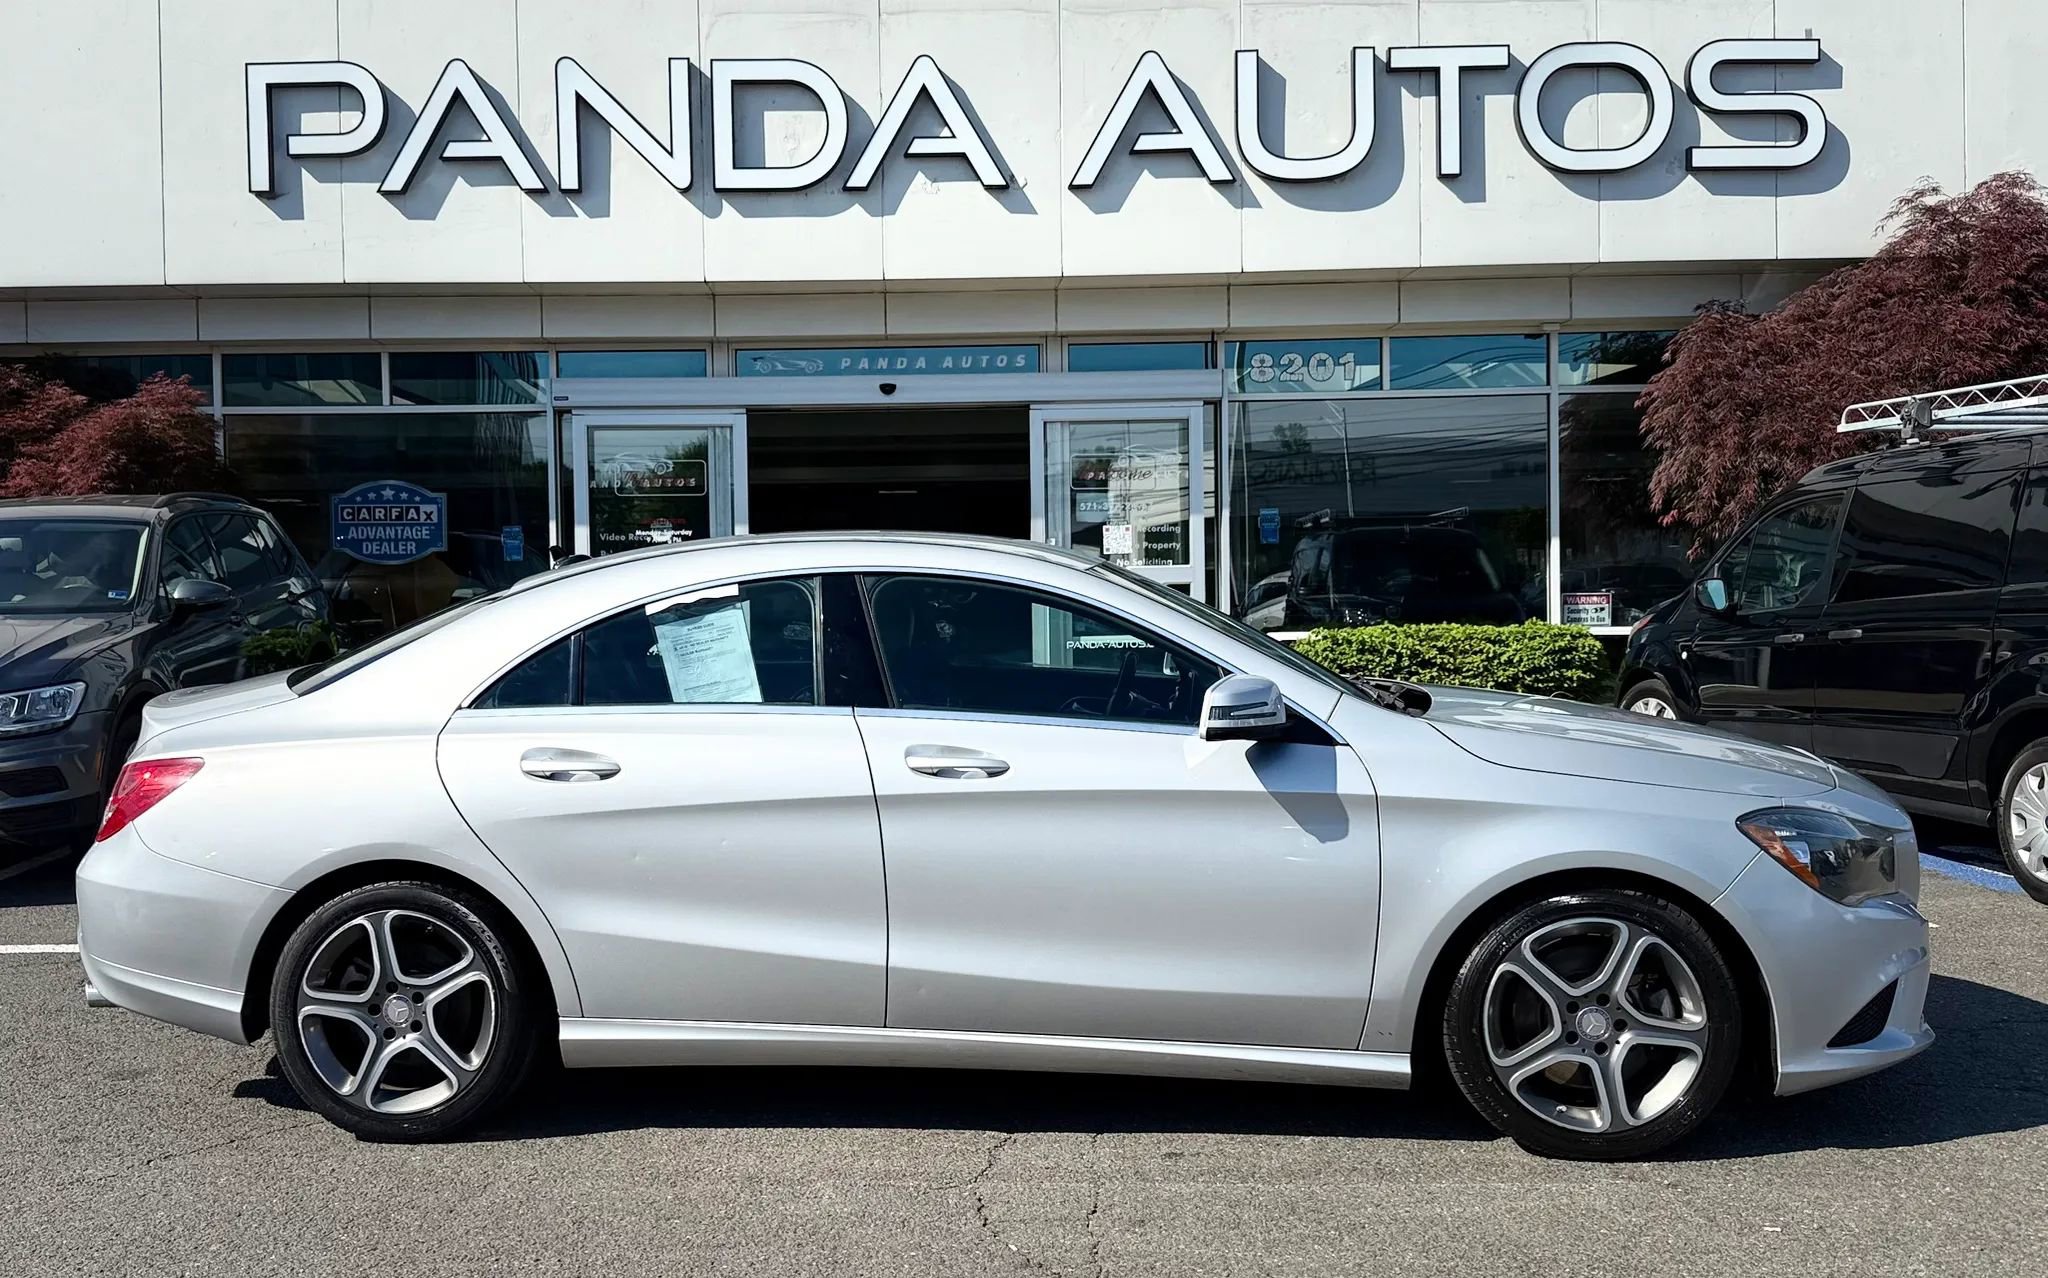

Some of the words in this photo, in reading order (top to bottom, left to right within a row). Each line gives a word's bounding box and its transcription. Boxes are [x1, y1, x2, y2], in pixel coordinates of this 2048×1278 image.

[245, 54, 1010, 195] PANDA
[1067, 37, 1827, 191] AUTOS
[840, 356, 927, 370] PANDA
[943, 354, 1027, 368] AUTOS
[1250, 351, 1356, 383] 8201
[341, 506, 436, 523] CARFAX
[347, 526, 431, 540] ADVANTAGE
[599, 533, 626, 541] Video
[362, 541, 417, 555] DEALER
[1142, 542, 1181, 550] Property
[1116, 558, 1130, 567] No
[1133, 558, 1173, 567] Soliciting
[1566, 595, 1607, 604] WARNING
